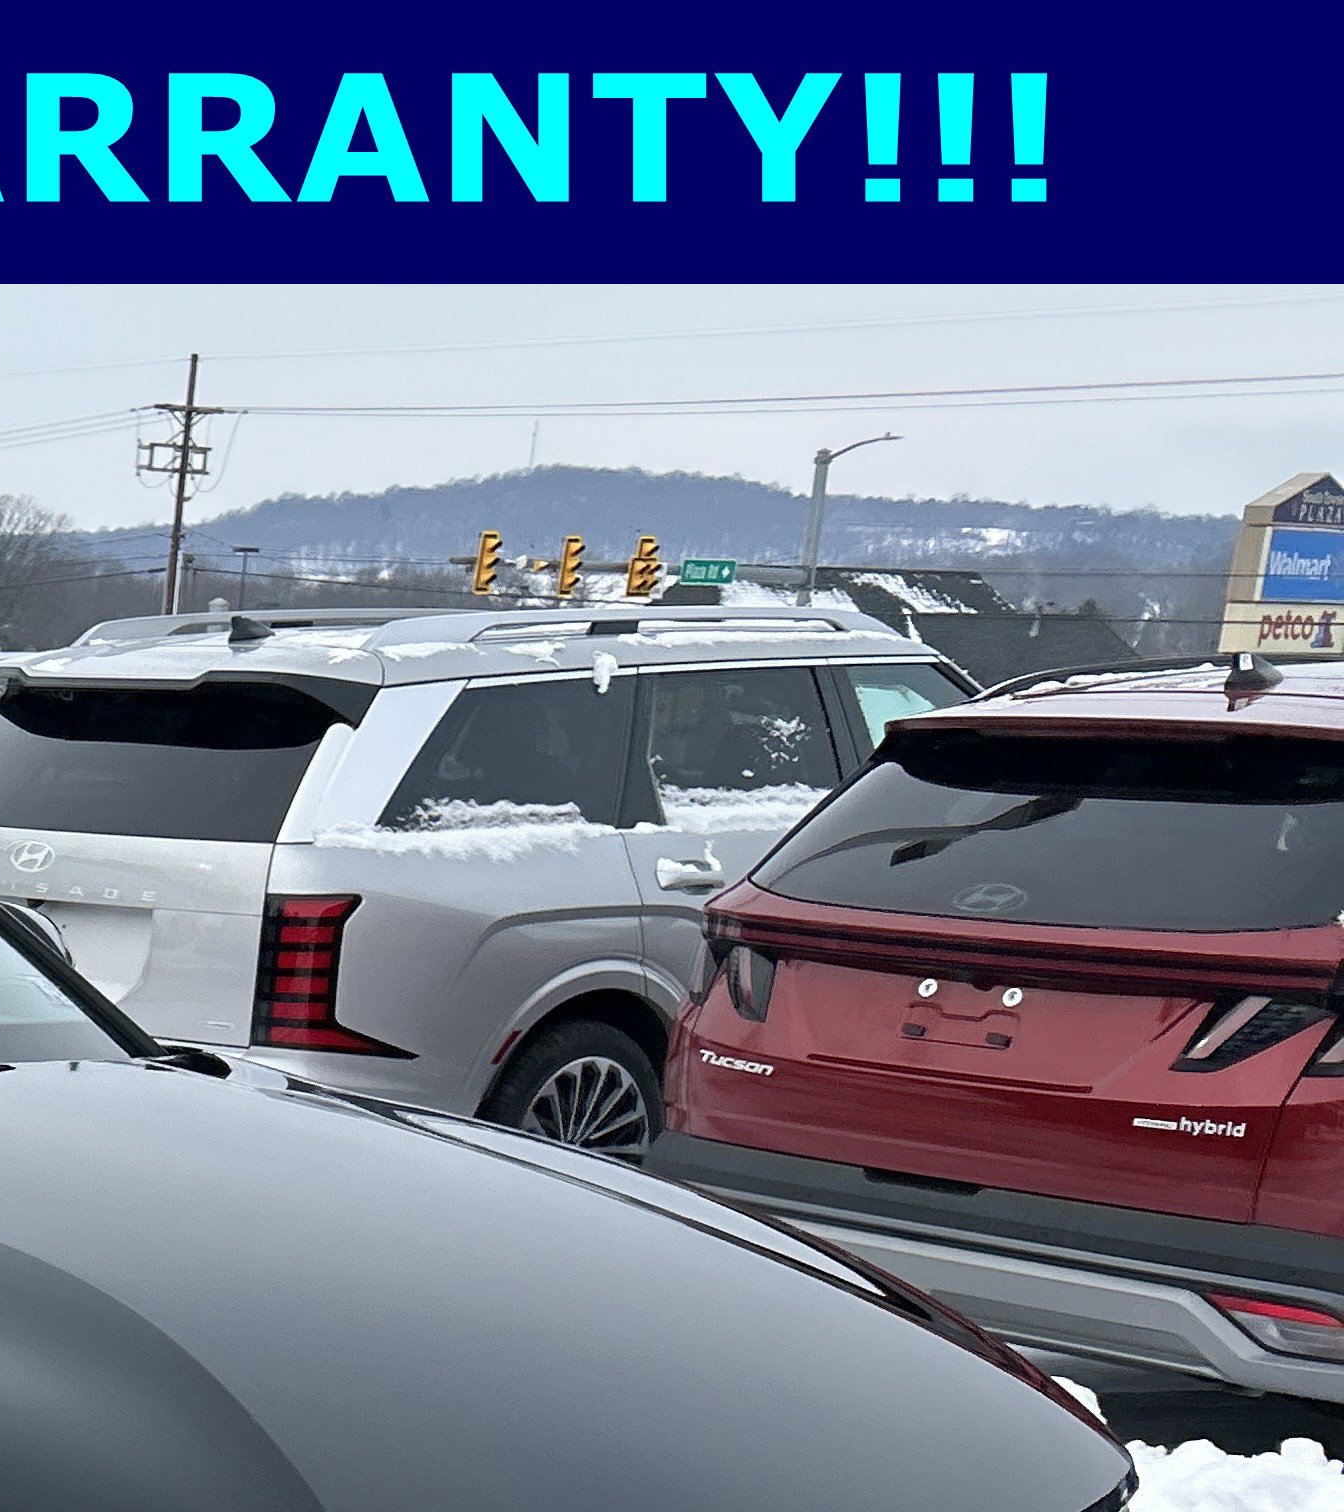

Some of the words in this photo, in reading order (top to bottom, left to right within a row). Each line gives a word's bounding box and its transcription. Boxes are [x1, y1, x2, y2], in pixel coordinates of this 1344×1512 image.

[1269, 549, 1332, 577] Walmart
[1258, 608, 1314, 648] petco
[1178, 1116, 1247, 1138] hybrid
